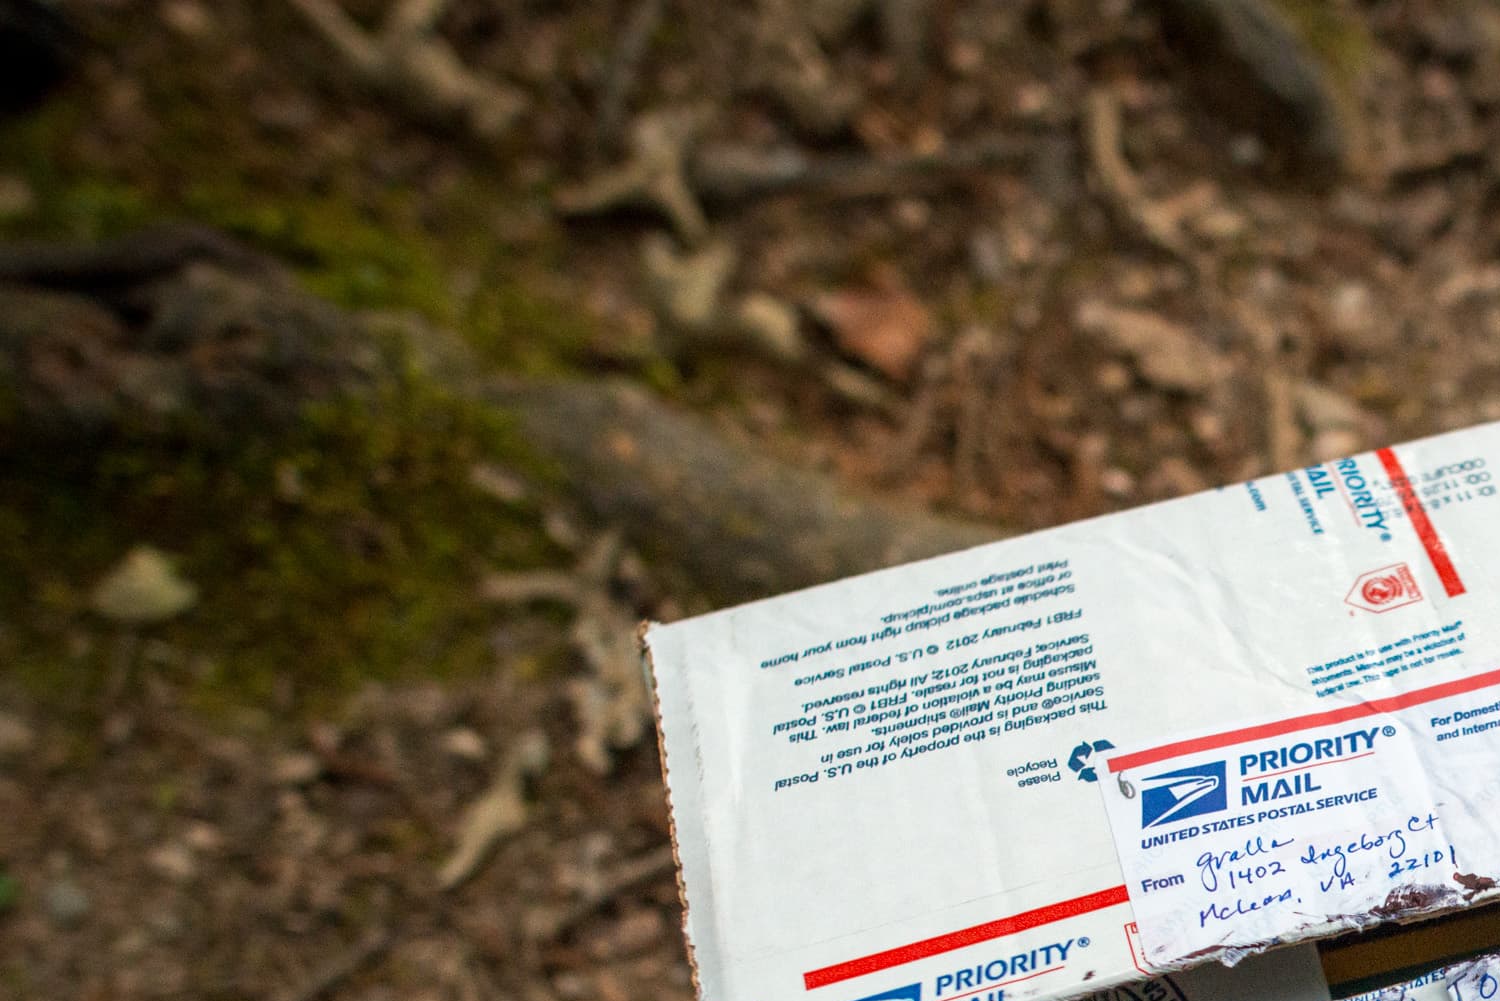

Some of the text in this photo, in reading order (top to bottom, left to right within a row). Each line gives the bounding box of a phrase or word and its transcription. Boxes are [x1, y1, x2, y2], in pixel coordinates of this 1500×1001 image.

[794, 608, 1082, 686] FRB1 February 2012 U.S. Postal Service
[971, 647, 1032, 670] February
[773, 644, 1093, 736] packaging is not for resale. FRB1 U.S. Postal
[867, 678, 907, 695] rights
[909, 673, 928, 688] All
[1046, 672, 1100, 693] sending
[788, 659, 1096, 743] Misuse may be a violation of federal law. This
[801, 689, 865, 714] reserved.
[994, 686, 1043, 706] Priority
[996, 709, 1009, 720] is
[1011, 702, 1038, 718] and
[871, 711, 947, 736] shipments.
[932, 711, 993, 739] provided
[1431, 715, 1452, 728] For
[888, 730, 929, 748] solely
[1437, 728, 1460, 742] and
[774, 699, 1107, 792] This packaging is the property of the U.S. Postal
[836, 746, 862, 759] use
[865, 740, 885, 753] for
[820, 753, 833, 764] in
[1007, 758, 1058, 778] Recycle
[1017, 769, 1062, 788] Please
[1241, 773, 1321, 806] MAIL
[1141, 788, 1378, 849] UNITED STATES POSTAL SERVICE
[1229, 862, 1286, 889] 1402
[1408, 815, 1439, 832] Ct
[1388, 845, 1457, 878] 22101
[1141, 873, 1184, 892] From
